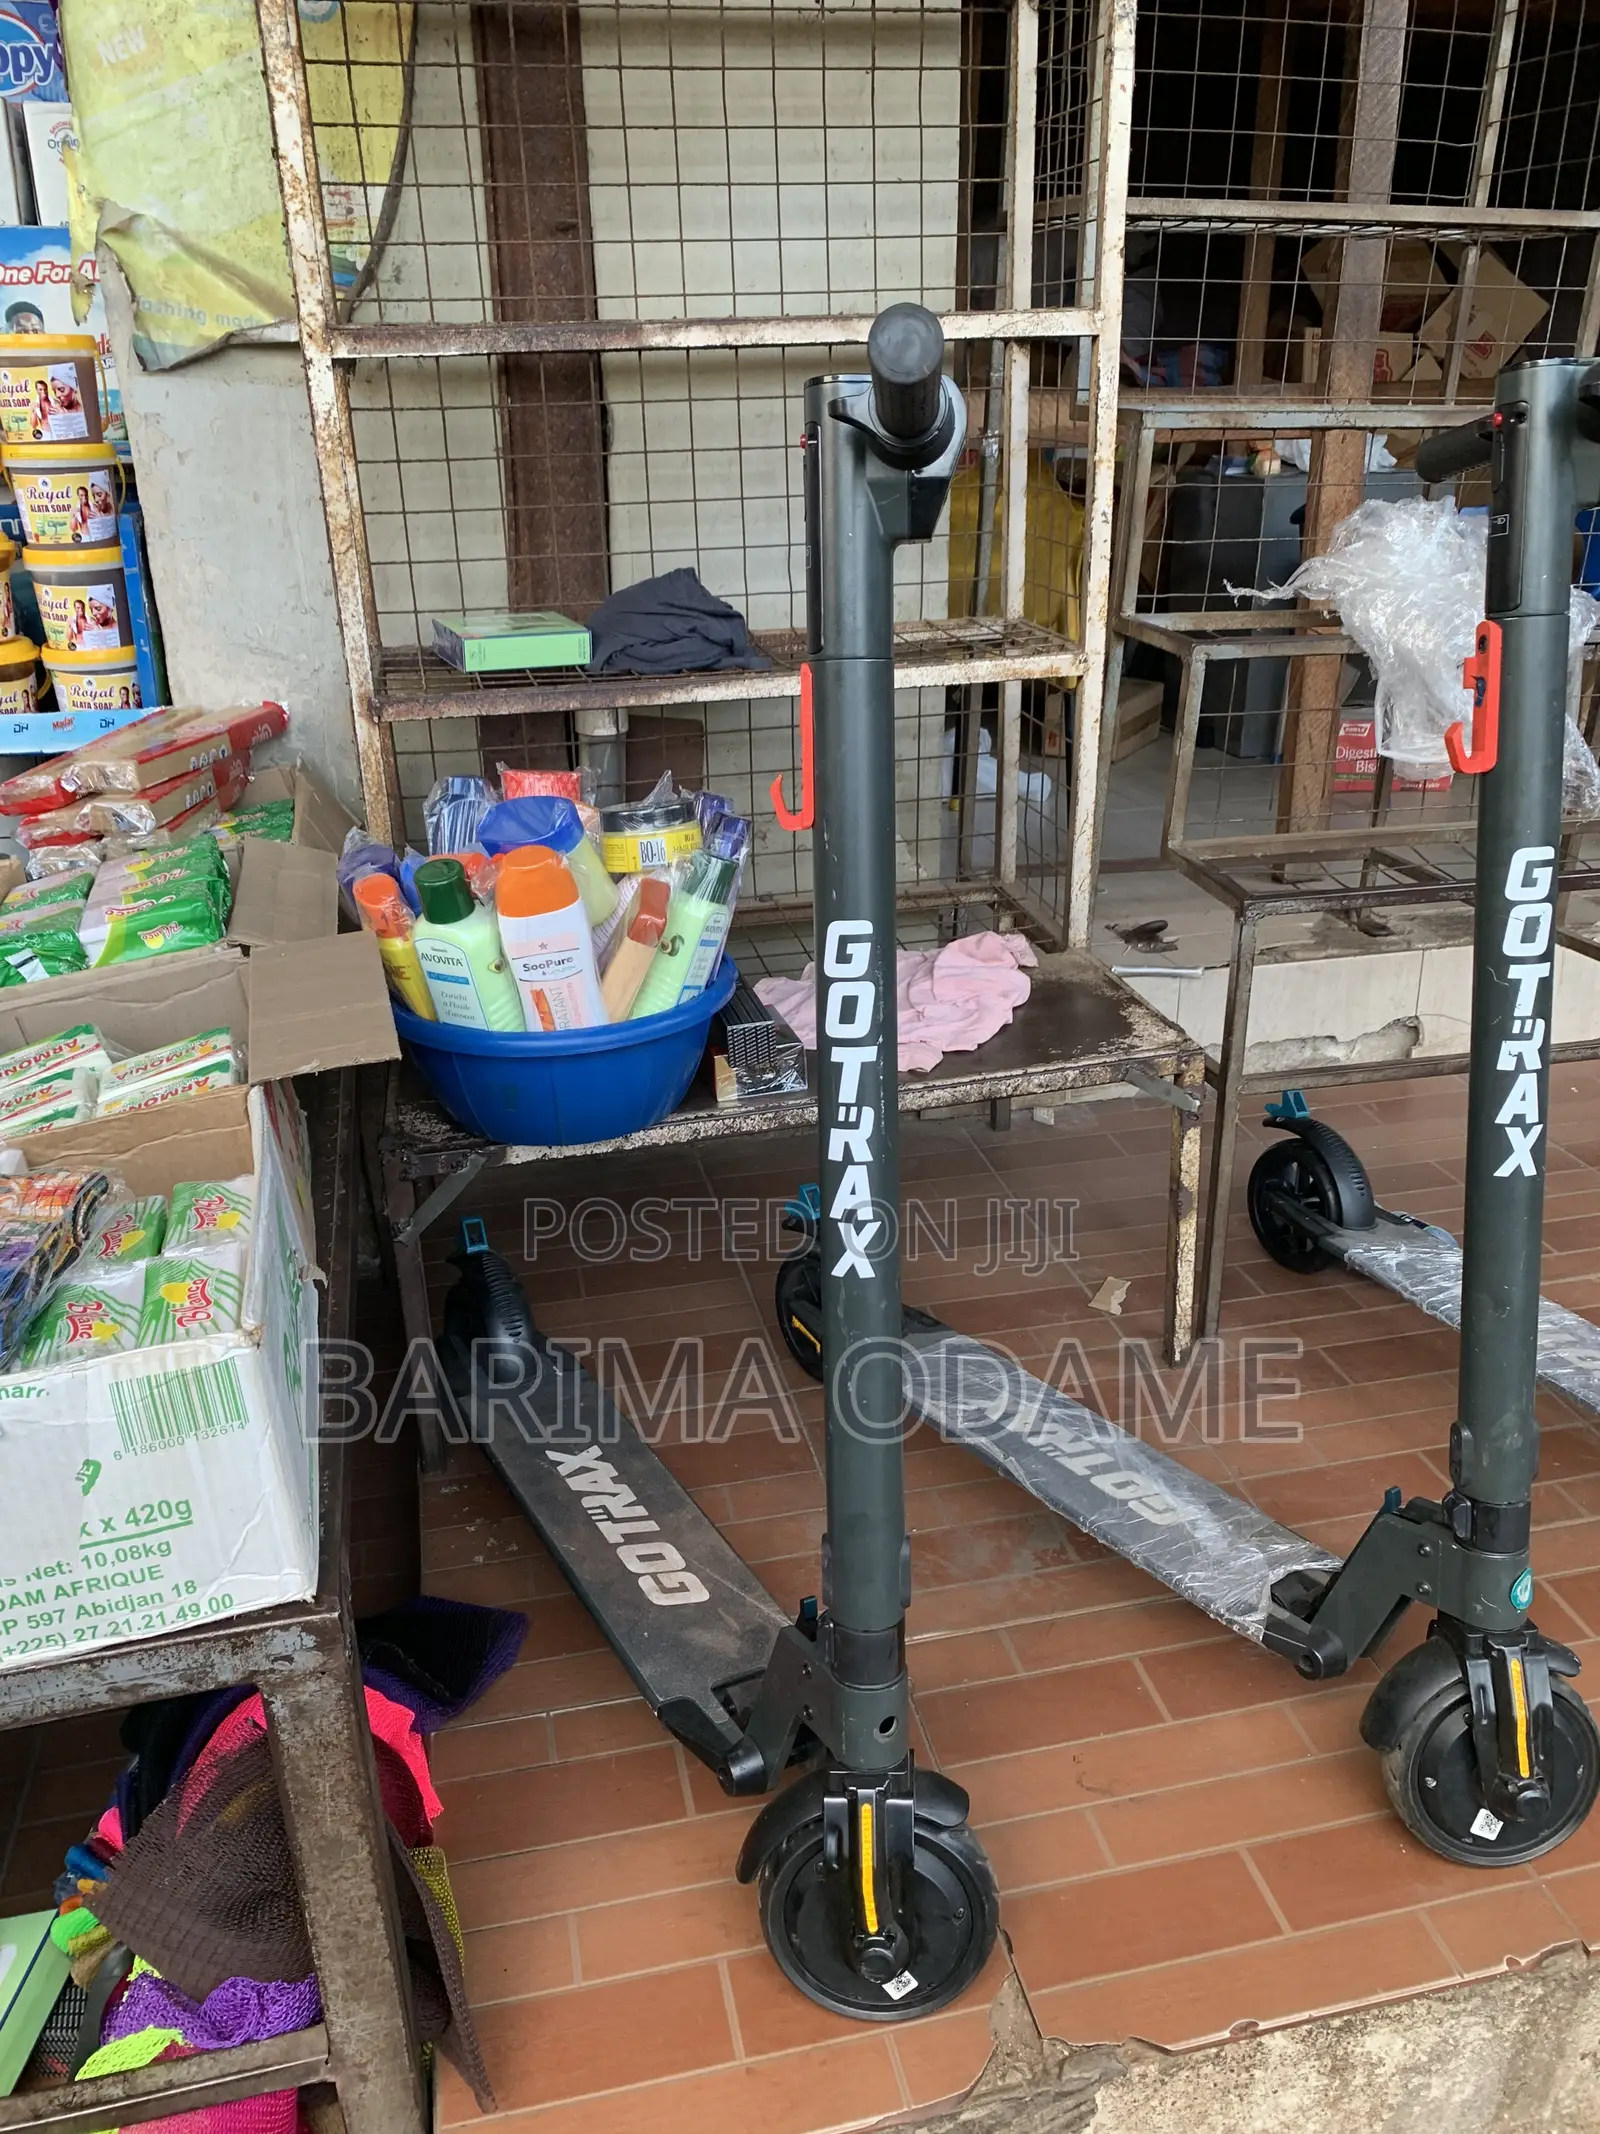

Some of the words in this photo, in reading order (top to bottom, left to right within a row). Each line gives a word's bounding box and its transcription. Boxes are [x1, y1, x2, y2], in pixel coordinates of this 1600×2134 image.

[96, 21, 147, 68] NEW
[0, 379, 31, 397] oyal
[12, 398, 31, 408] SOAP
[27, 486, 72, 503] Royal
[30, 504, 50, 513] ALATA
[52, 504, 72, 513] SOAP
[52, 612, 69, 622] SOAP
[69, 683, 116, 701] Royal
[72, 702, 91, 711] ALATA
[93, 702, 114, 711] SOAP
[639, 840, 666, 864] BO-16
[137, 921, 183, 940] Blanco
[420, 952, 464, 967] AVOVITA
[522, 955, 574, 973] SooPure
[1493, 845, 1555, 1178] GOTRAX
[116, 1039, 211, 1082] ARMONIA
[823, 920, 882, 1279] GOTRAX
[169, 1269, 221, 1329] Blanco
[113, 1450, 123, 1461] 6
[131, 1436, 186, 1457] 186000
[192, 1421, 246, 1442] 132614
[124, 1498, 193, 1527] 420g
[545, 1444, 710, 1606] GOTRAX
[80, 1539, 172, 1570] 10,08kg
[53, 1563, 164, 1601] AFRIQUE
[26, 1608, 66, 1630] 597
[75, 1590, 164, 1620] Abidjan
[171, 1579, 198, 1597] 18
[72, 1592, 235, 1643] 27.21.21.49.00
